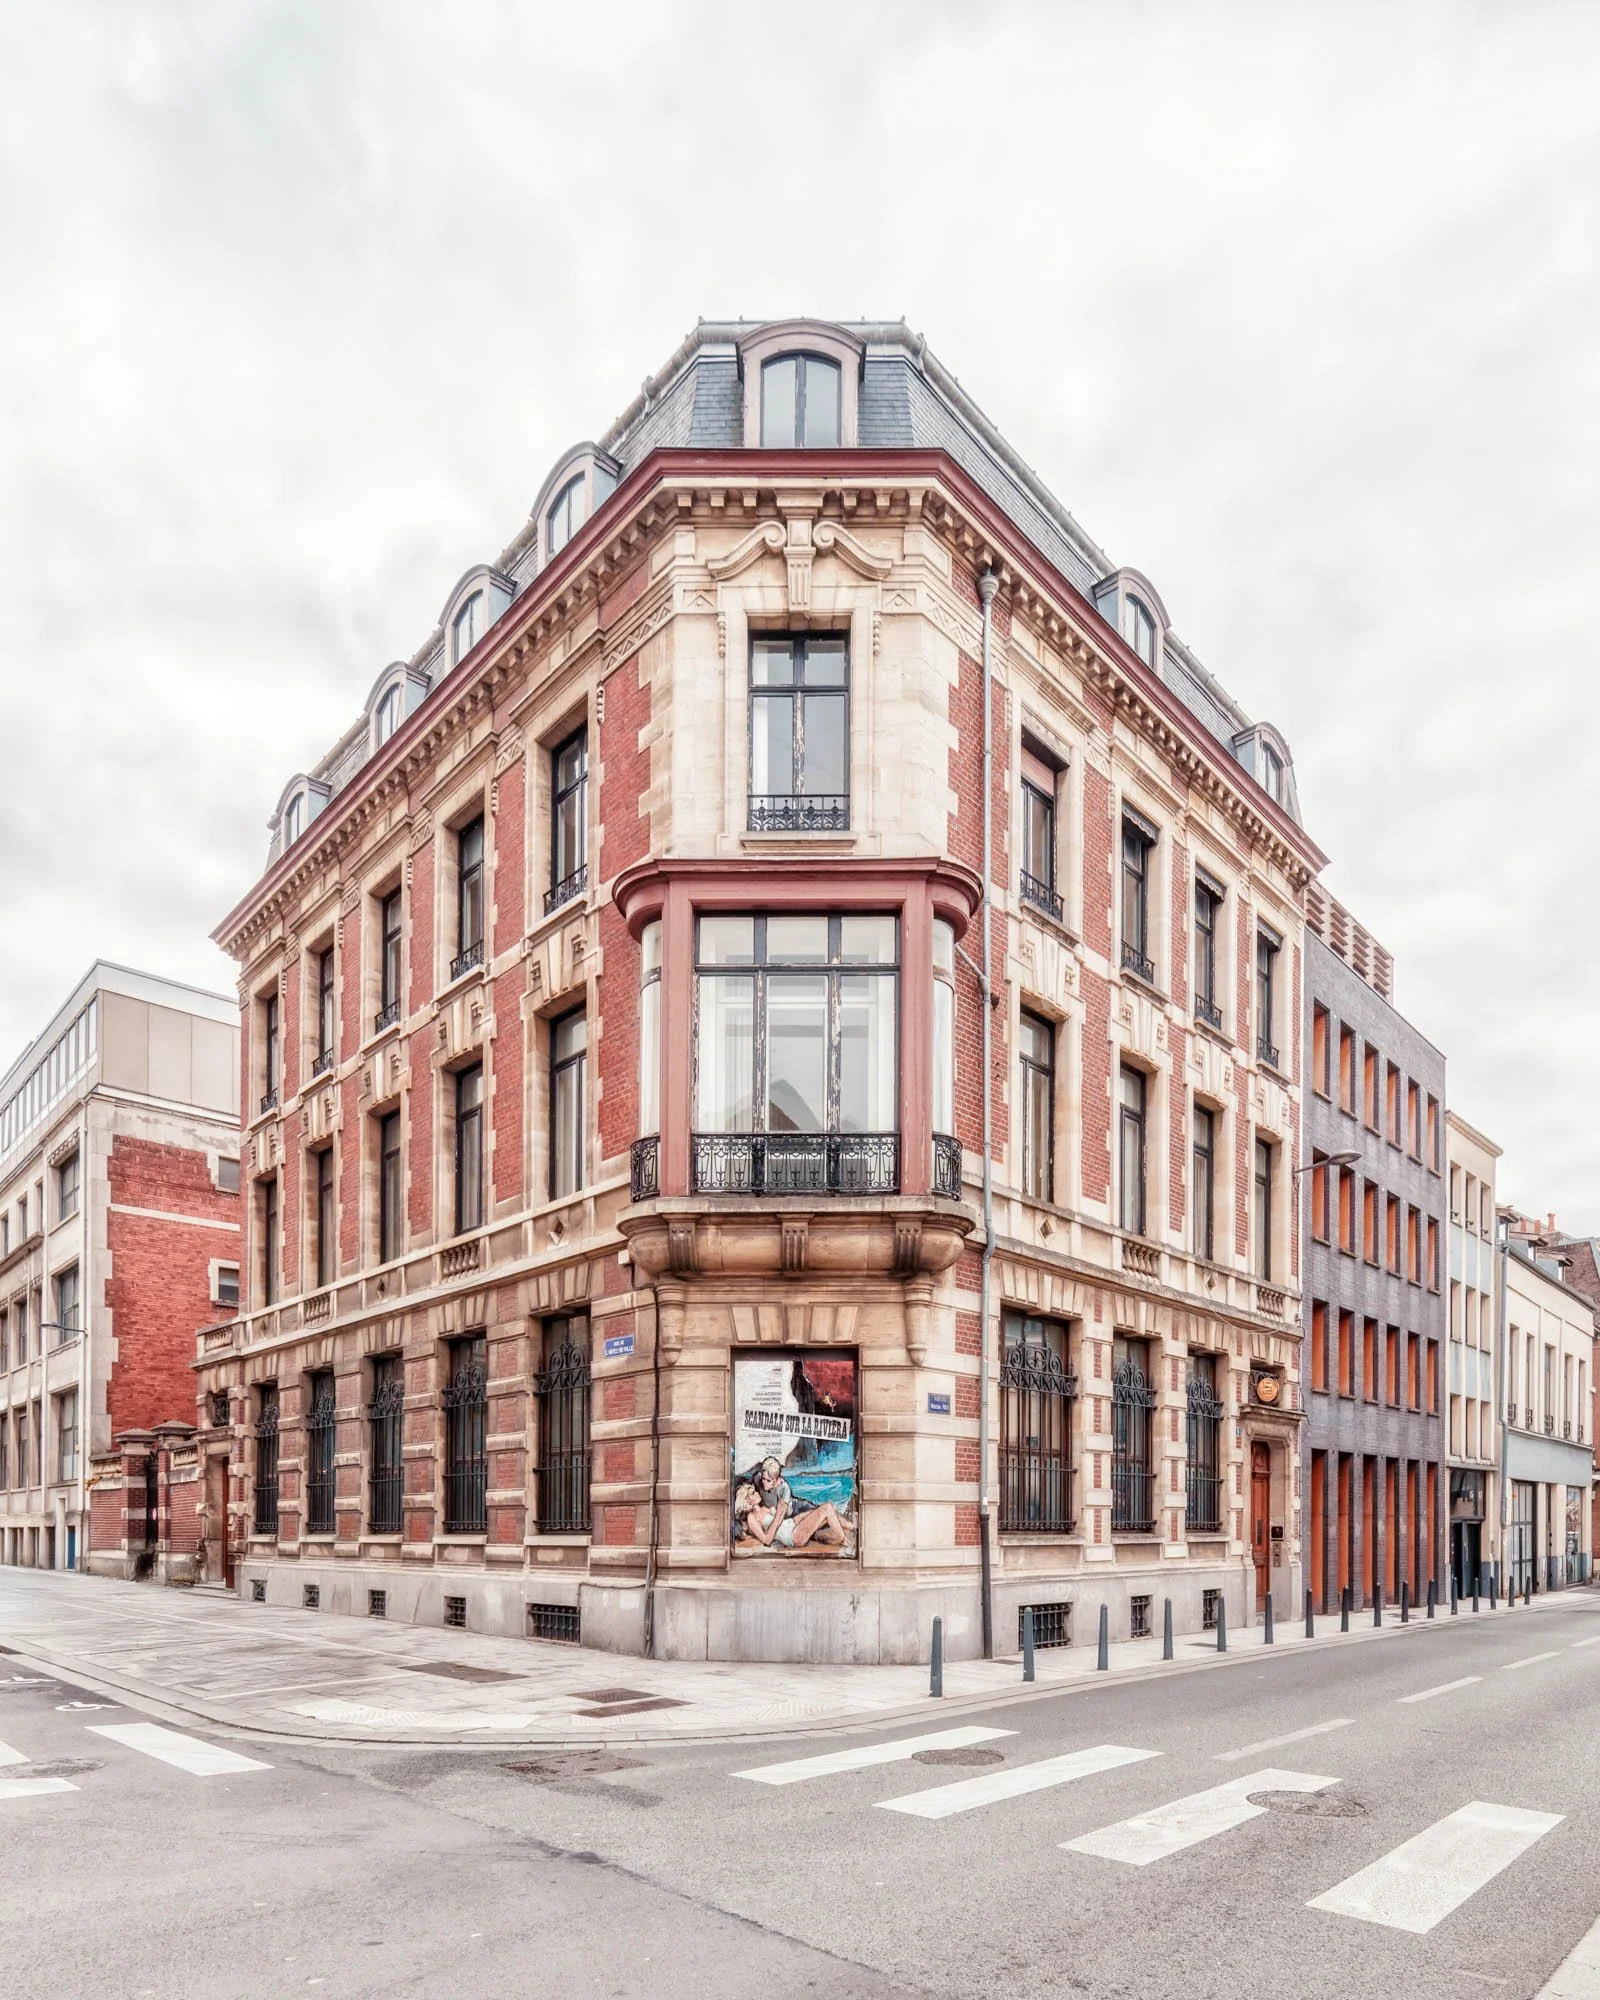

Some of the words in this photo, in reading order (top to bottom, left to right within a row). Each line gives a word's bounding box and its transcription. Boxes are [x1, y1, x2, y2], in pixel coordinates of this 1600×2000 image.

[744, 1410, 784, 1432] SCANDALE
[785, 1414, 800, 1434] SUR
[801, 1416, 813, 1436] LA
[813, 1418, 848, 1440] RIVIERA
